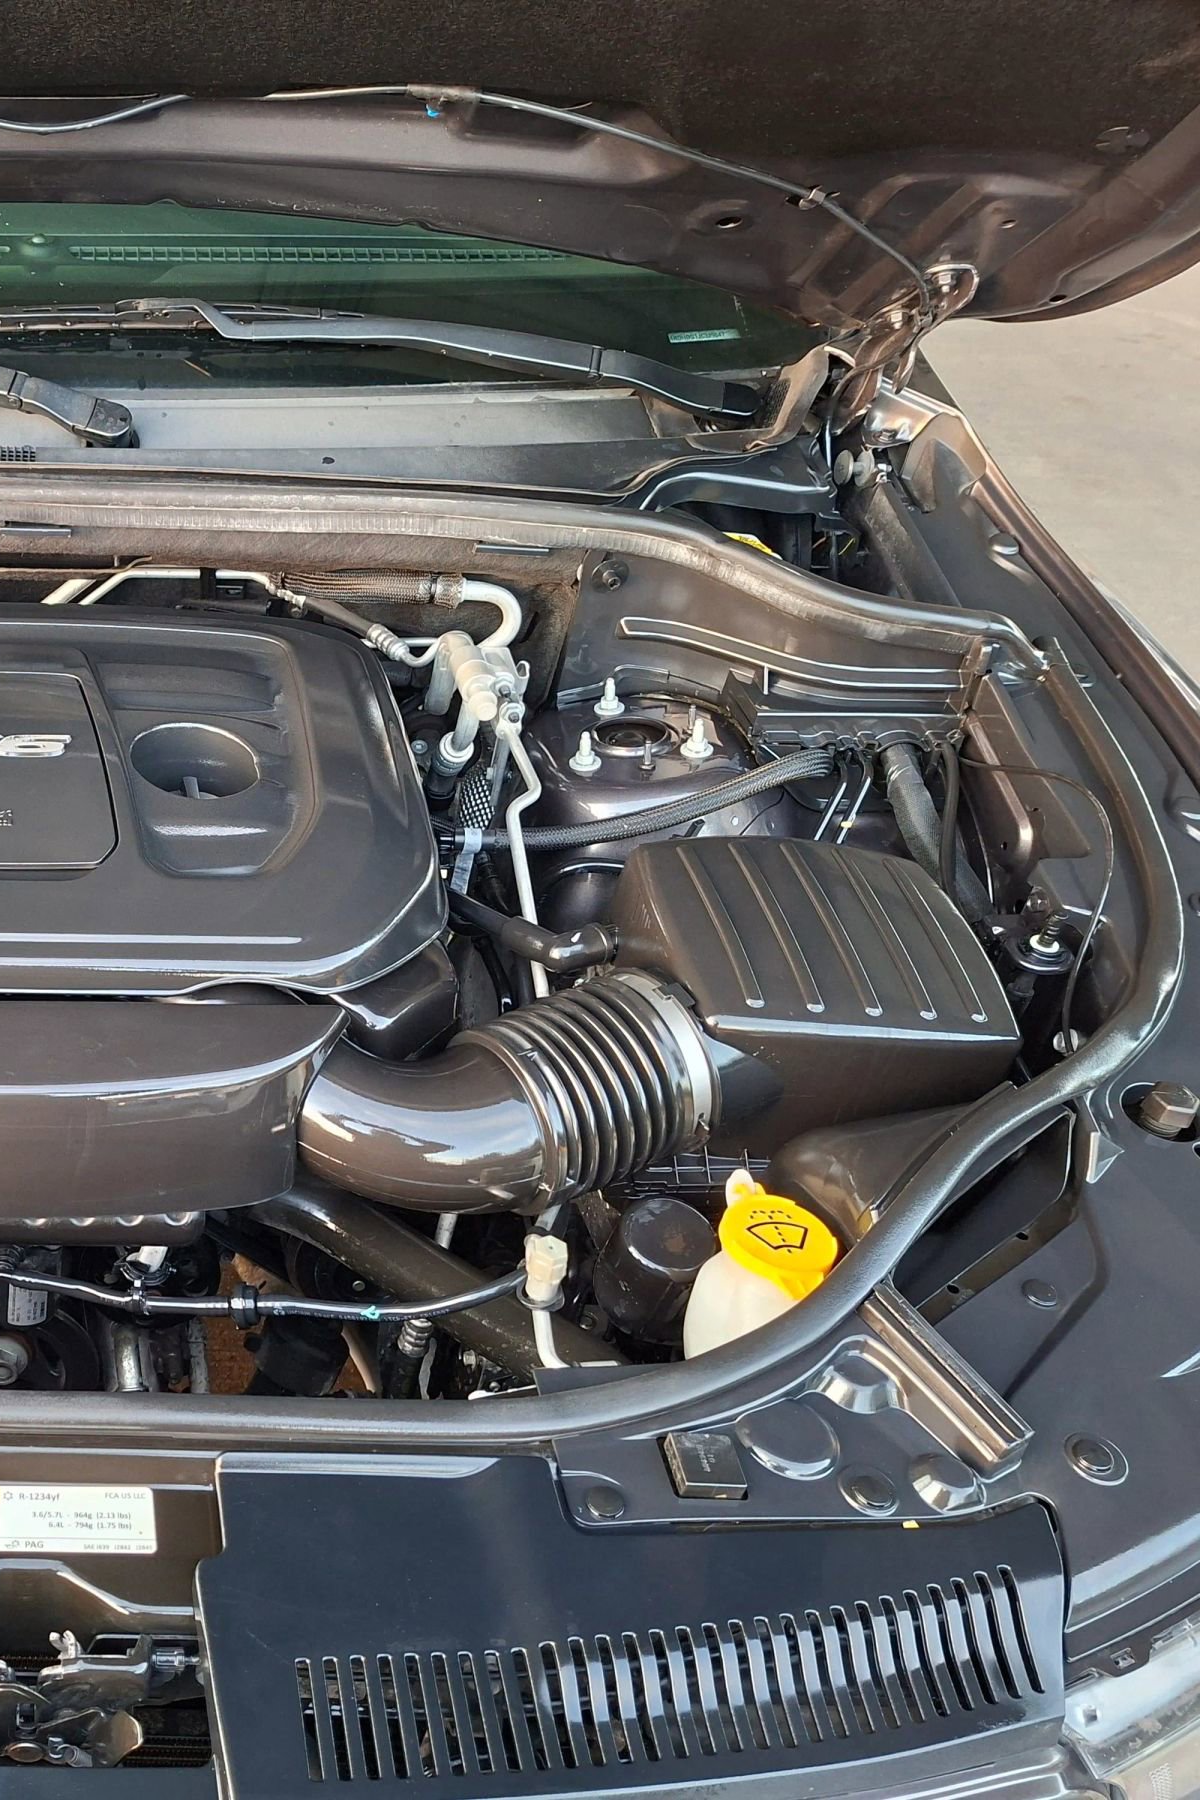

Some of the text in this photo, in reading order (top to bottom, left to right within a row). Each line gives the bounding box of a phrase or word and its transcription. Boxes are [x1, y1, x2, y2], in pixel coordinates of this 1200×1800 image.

[19, 1492, 60, 1501] R-1234yf
[32, 1511, 63, 1519] 3.6/5.7L
[74, 1511, 92, 1520] 964g
[96, 1512, 115, 1520] (2.13
[117, 1512, 131, 1520] lbs)
[75, 1521, 93, 1530] 794g
[96, 1522, 116, 1530] (1.75
[118, 1522, 132, 1530] lbs)
[24, 1540, 44, 1549] PAG
